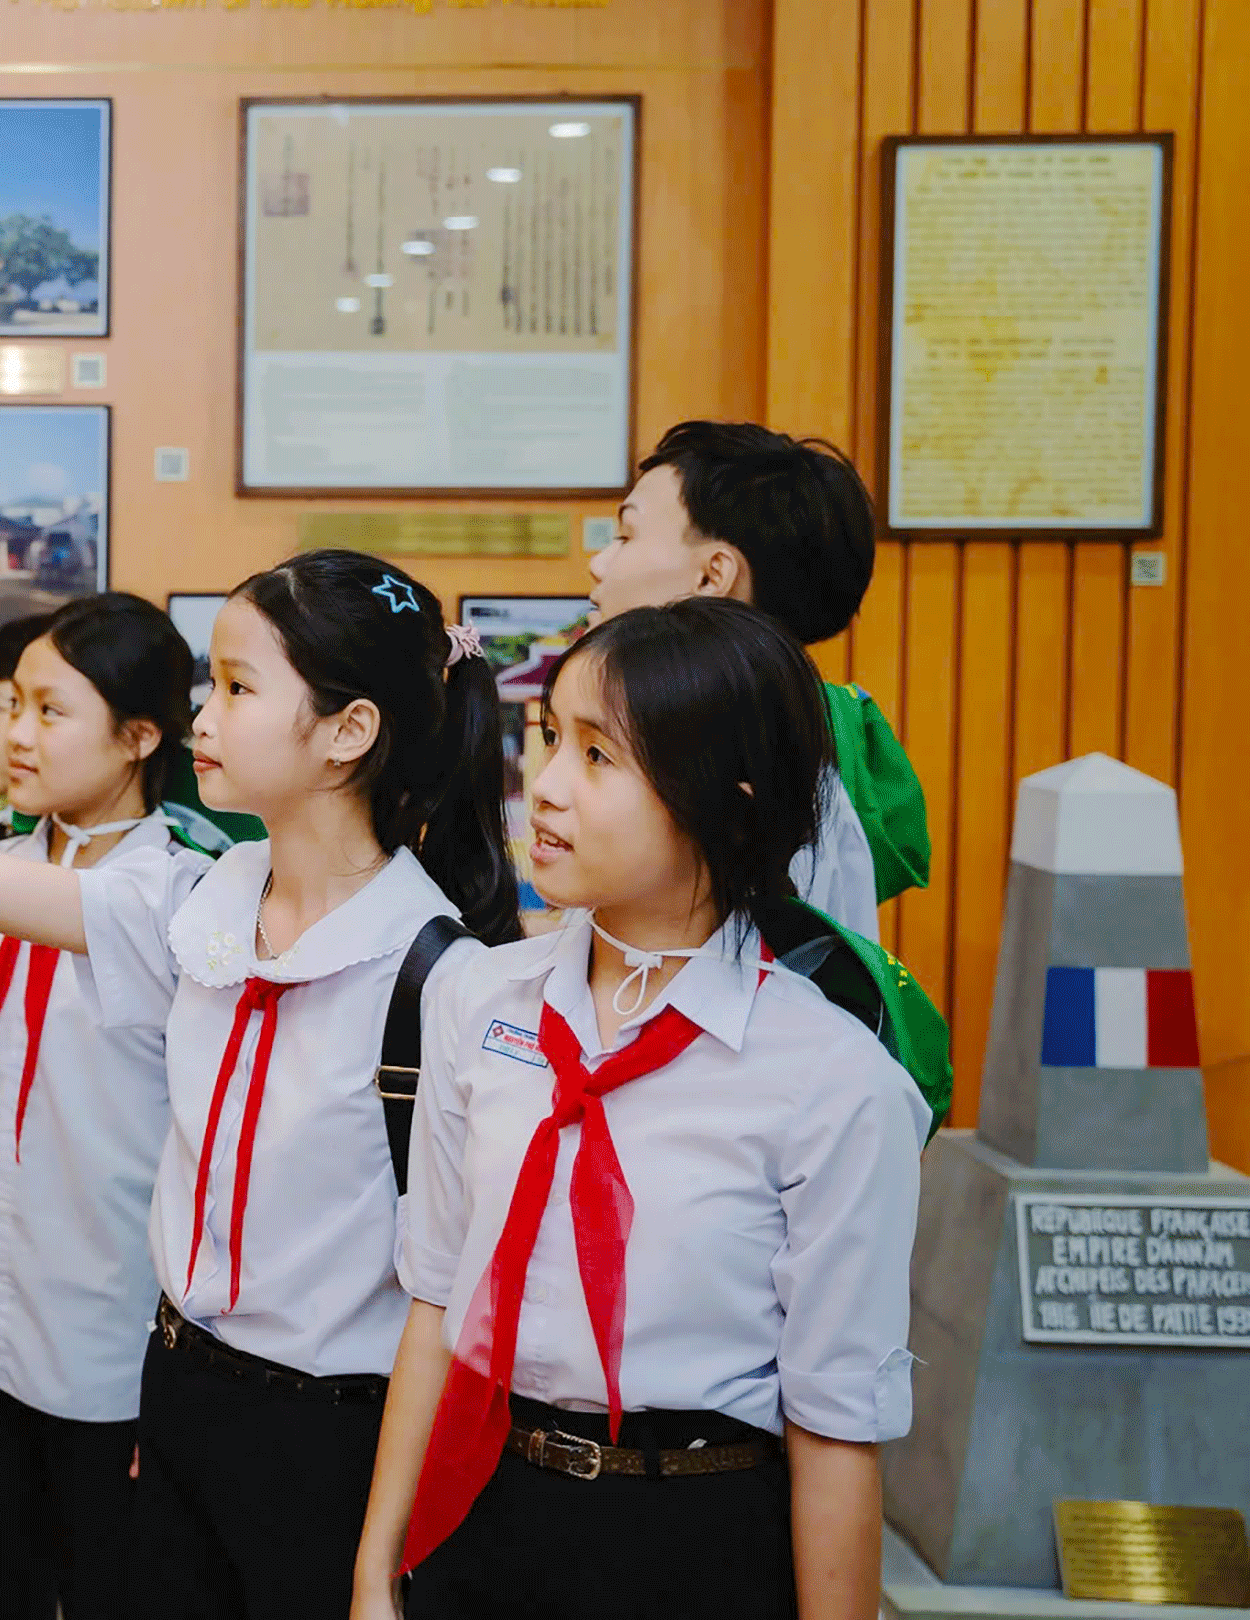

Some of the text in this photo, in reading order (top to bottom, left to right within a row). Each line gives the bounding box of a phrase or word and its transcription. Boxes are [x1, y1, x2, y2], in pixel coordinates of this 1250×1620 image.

[1053, 1235, 1141, 1266] EMPIRE
[1134, 1267, 1170, 1294] DES
[1117, 1303, 1148, 1332] DE
